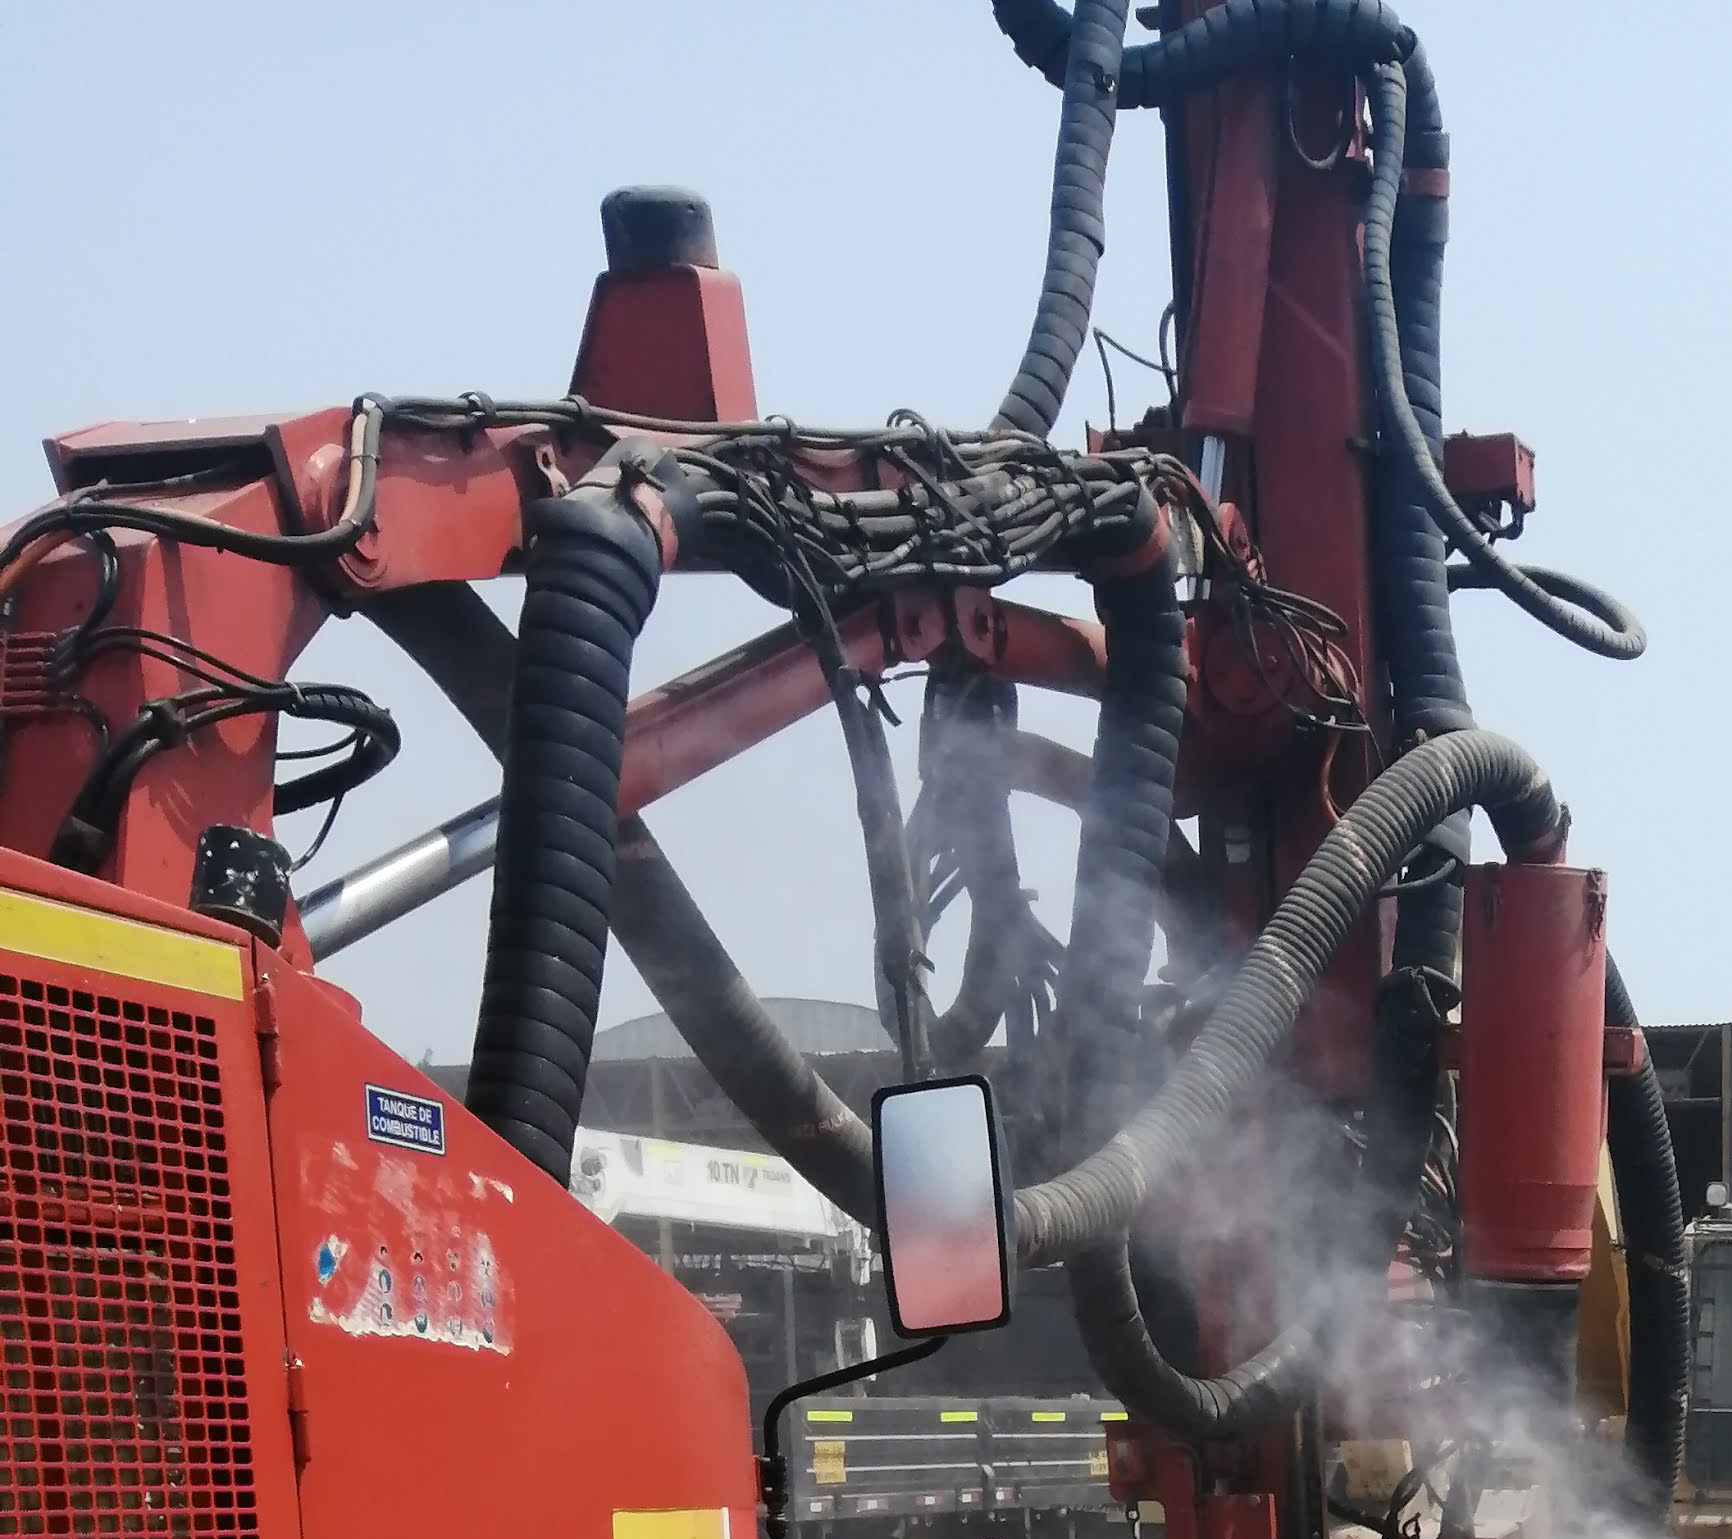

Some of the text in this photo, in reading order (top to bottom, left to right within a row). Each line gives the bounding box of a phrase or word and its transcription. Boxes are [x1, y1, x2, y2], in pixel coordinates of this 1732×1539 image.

[377, 1096, 432, 1124] TANQUE DE
[372, 1115, 440, 1145] COMBUSTIBLE
